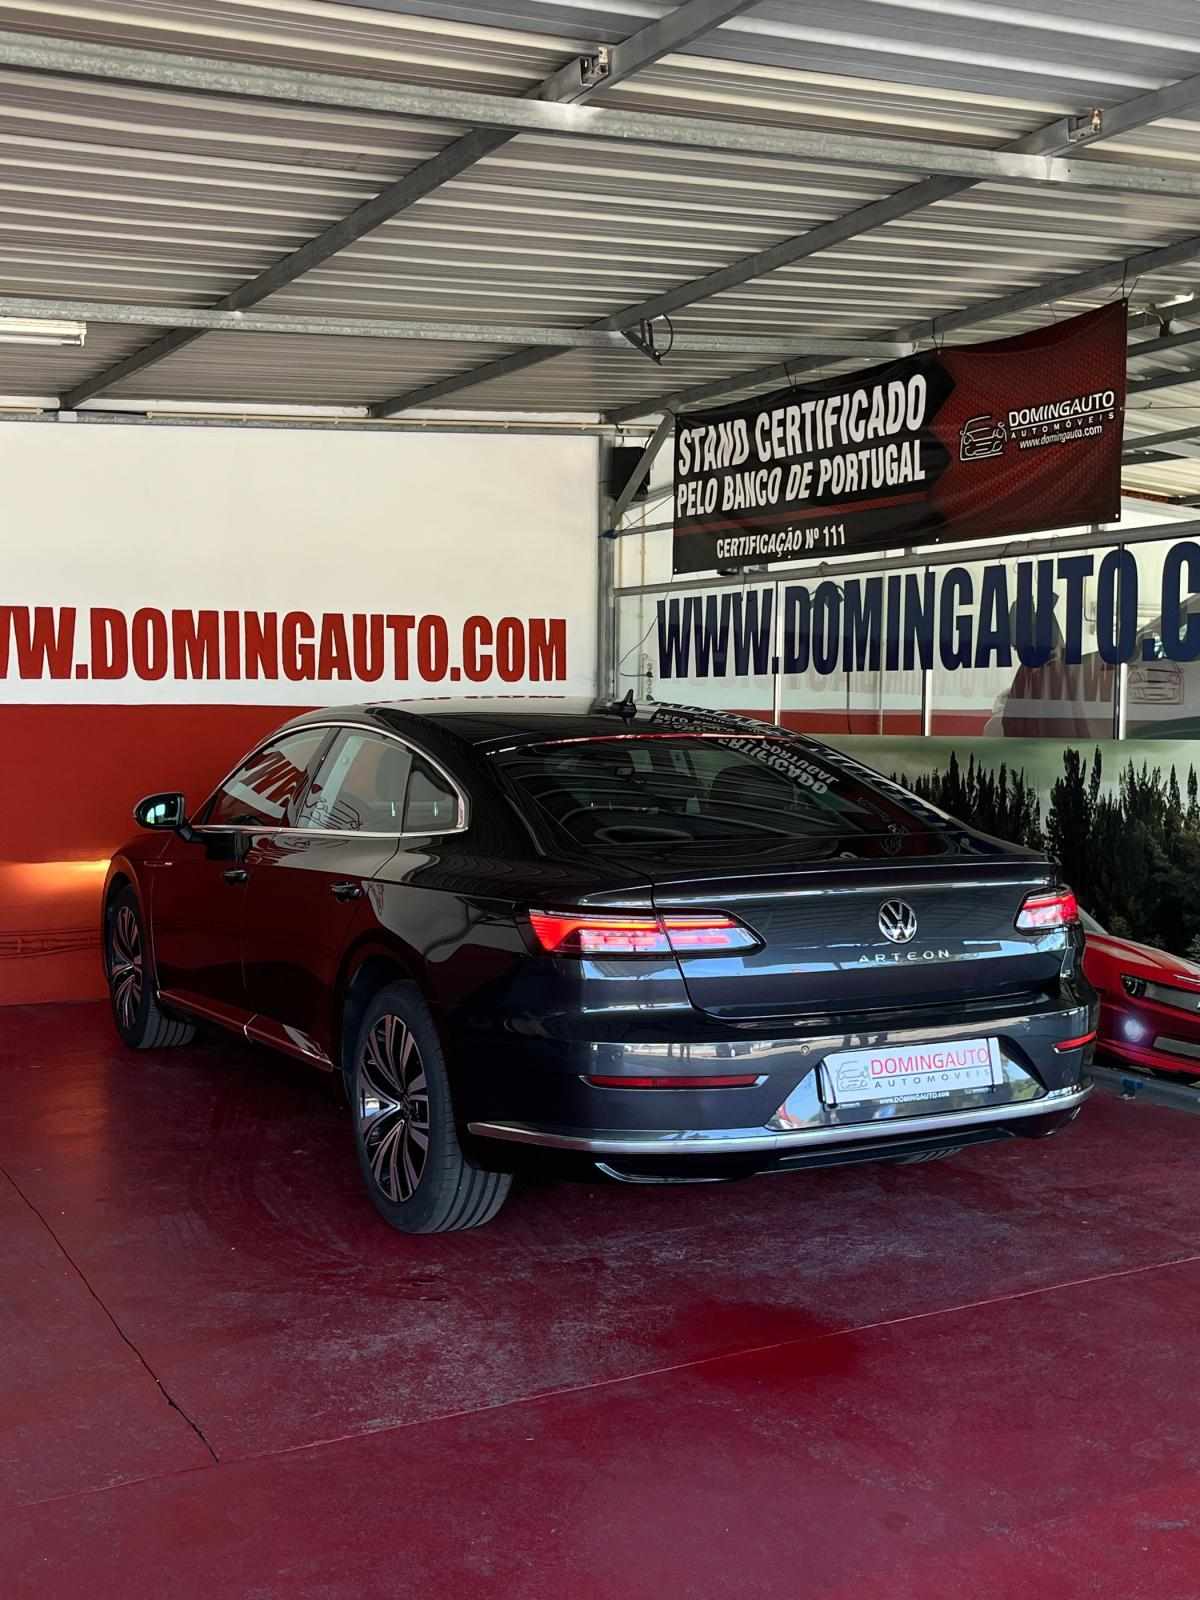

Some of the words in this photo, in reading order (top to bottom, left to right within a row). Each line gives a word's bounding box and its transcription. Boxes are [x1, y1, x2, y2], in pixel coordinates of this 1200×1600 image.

[678, 418, 750, 476] STAND
[755, 374, 927, 462] CERTIFICADO
[1008, 391, 1115, 427] DOMINGAUTO
[1019, 425, 1103, 449] www.domingauto.com
[677, 478, 718, 518] PELO
[721, 466, 783, 512] BANCO
[785, 461, 814, 502] DE
[816, 439, 926, 497] PORTUGAL
[717, 526, 802, 559] CERTIFICAÇÃO
[805, 526, 820, 549] Nº
[822, 524, 846, 547] 111
[0, 606, 568, 682] W.DOMINGAUTO.COM
[858, 949, 950, 963] ARTEON
[870, 1047, 989, 1076] DOMINGAUTO
